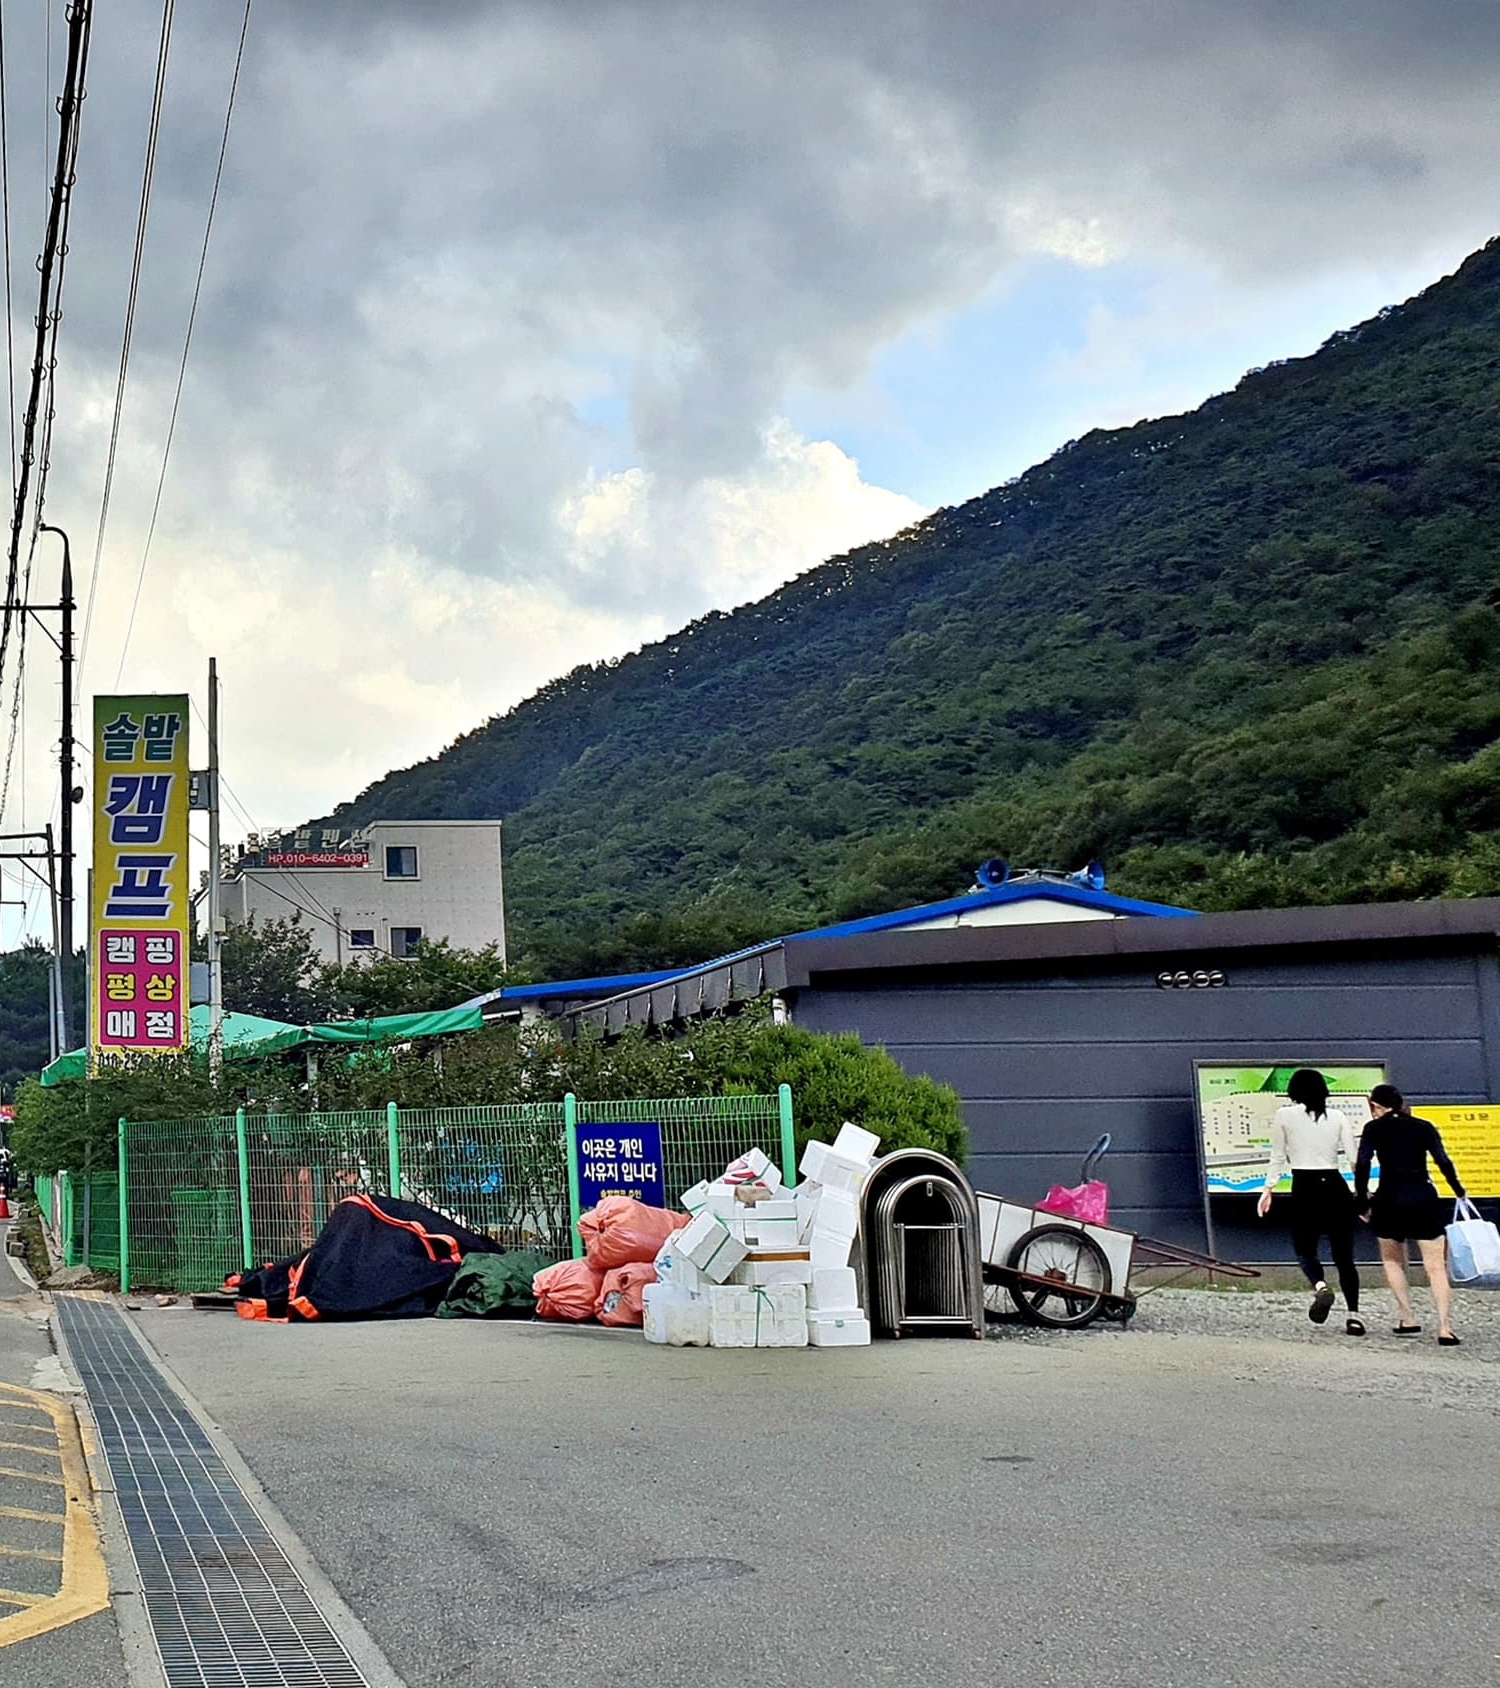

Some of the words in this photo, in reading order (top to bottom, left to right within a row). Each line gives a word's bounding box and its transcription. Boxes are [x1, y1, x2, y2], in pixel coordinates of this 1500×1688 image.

[102, 712, 181, 763] 솔밭
[101, 771, 177, 918] 캠프
[106, 936, 174, 964] 캠핑
[106, 973, 177, 1001] 평상
[106, 1010, 174, 1038] 매점
[582, 1138, 617, 1158] 이곳은
[619, 1138, 643, 1158] 개인
[583, 1162, 618, 1182] 사유지
[621, 1162, 658, 1182] 입니다
